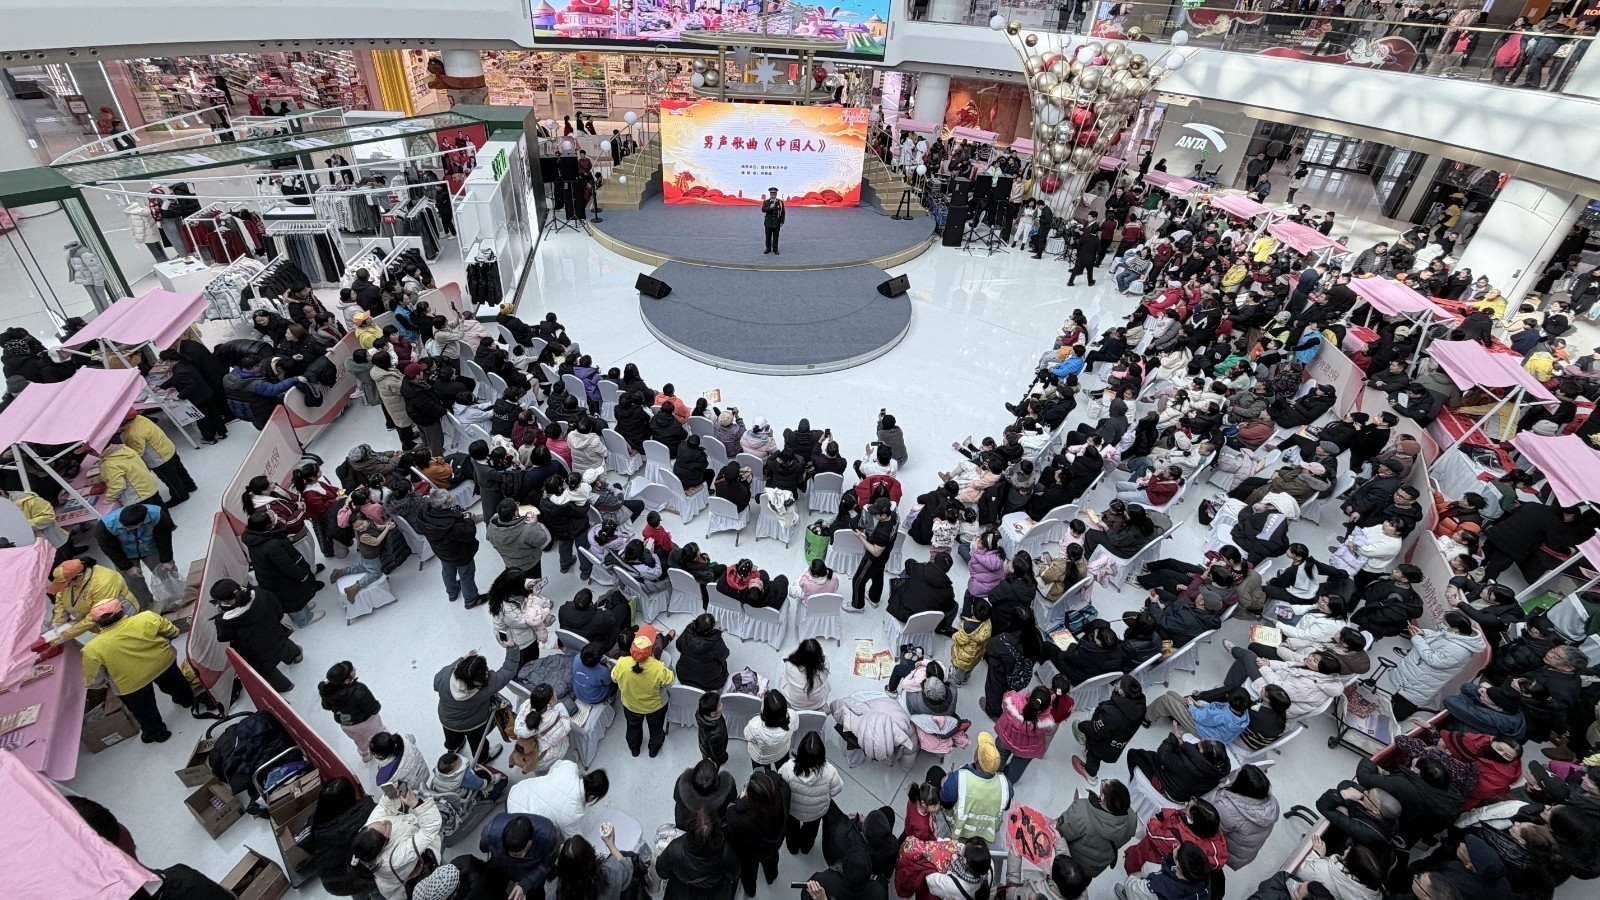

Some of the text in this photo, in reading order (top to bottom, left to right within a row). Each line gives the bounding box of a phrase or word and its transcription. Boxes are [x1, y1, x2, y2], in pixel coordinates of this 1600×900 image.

[703, 135, 826, 153] 男声歌曲《中国人》
[1175, 135, 1208, 150] ANTA
